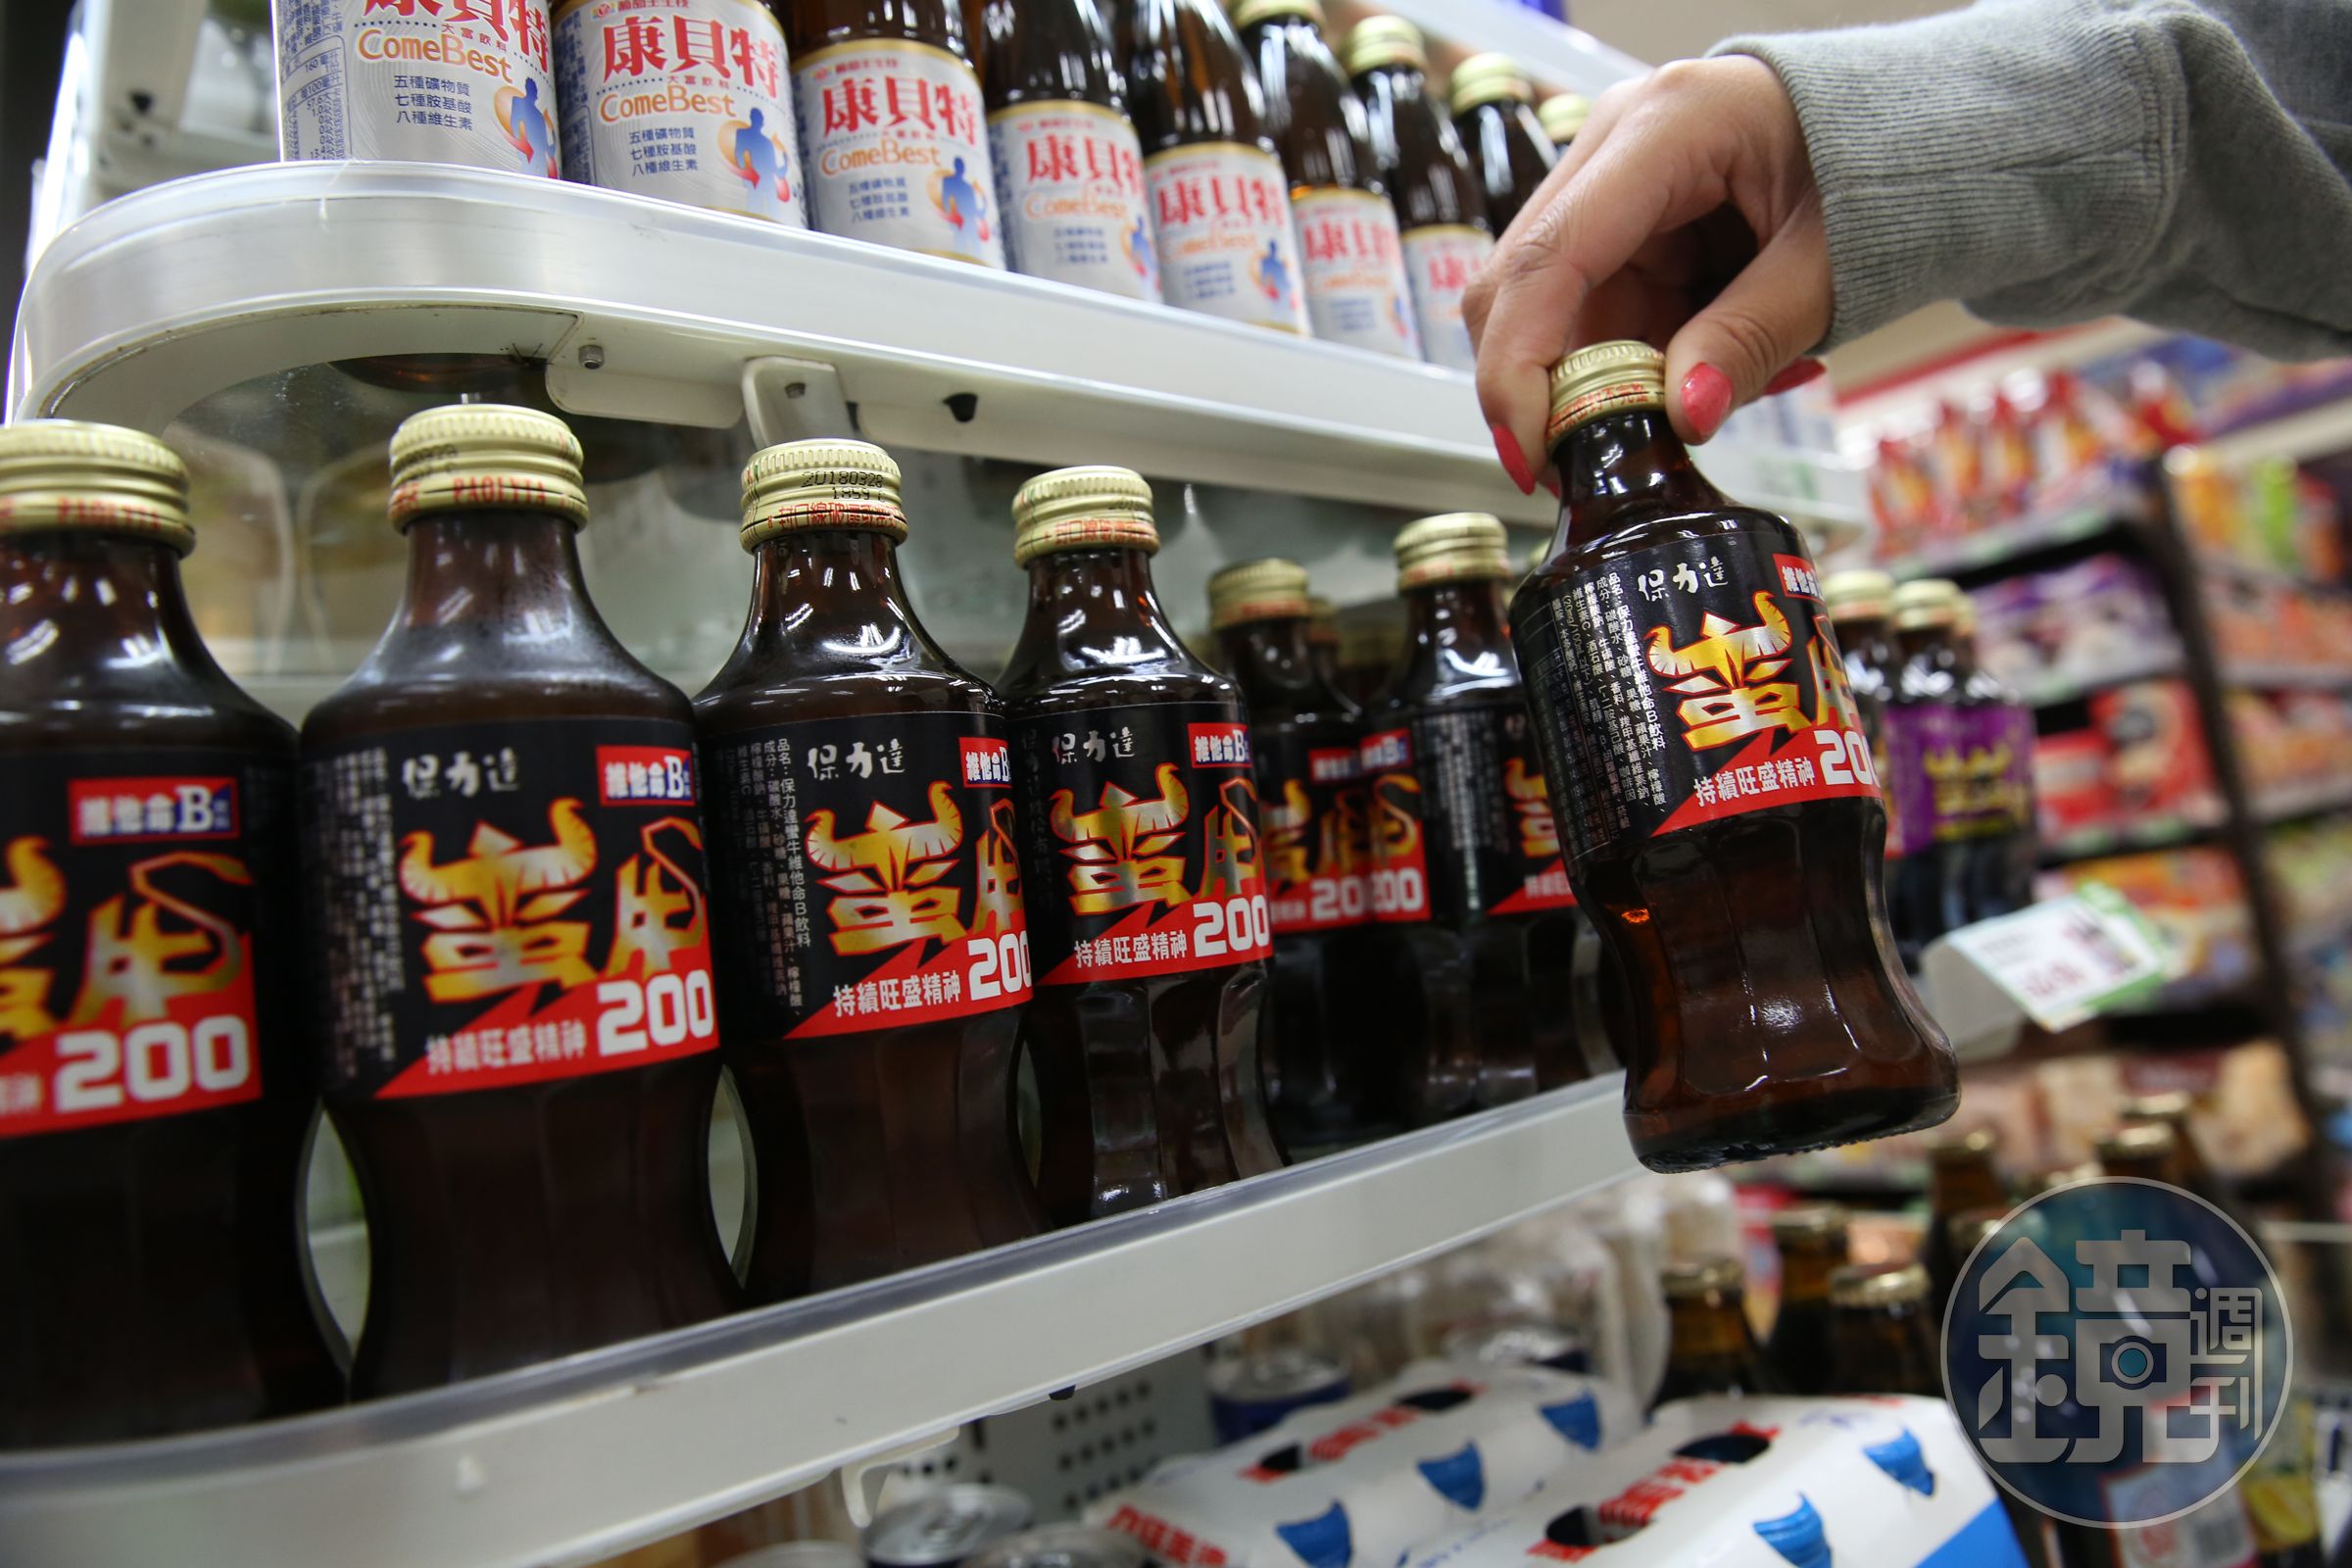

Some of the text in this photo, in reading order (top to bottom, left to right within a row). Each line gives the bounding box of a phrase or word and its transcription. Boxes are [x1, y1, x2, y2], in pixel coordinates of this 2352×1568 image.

[360, 28, 514, 83] ComeBest
[364, 0, 549, 74] 貝特
[603, 15, 778, 99] 康貝特
[394, 74, 470, 97] 五種礦物質
[394, 94, 472, 115] 七種胺基酸
[600, 85, 737, 122] ComeBest
[396, 111, 473, 131] 八種維生素
[822, 74, 976, 146] 康貝特
[628, 127, 696, 145] 五種礦物質
[630, 143, 697, 161] 七種胺基酸
[821, 137, 944, 177] ComeBest
[632, 159, 699, 176] 八種維生素
[453, 475, 547, 504] PAOLYTA
[801, 470, 884, 488] 20180328
[1638, 556, 1729, 603] 保力達
[807, 738, 906, 781] 保力達
[1052, 725, 1135, 764] 保力達
[402, 748, 518, 799] 保力達
[1693, 756, 1816, 808] 持續旺盛精神
[1074, 930, 1188, 969] 持續旺盛精神
[1193, 894, 1270, 956] 200
[833, 969, 961, 1017] 持續旺盛精神
[425, 969, 714, 1075] 持續旺盛精神 200
[54, 1013, 251, 1114] 200
